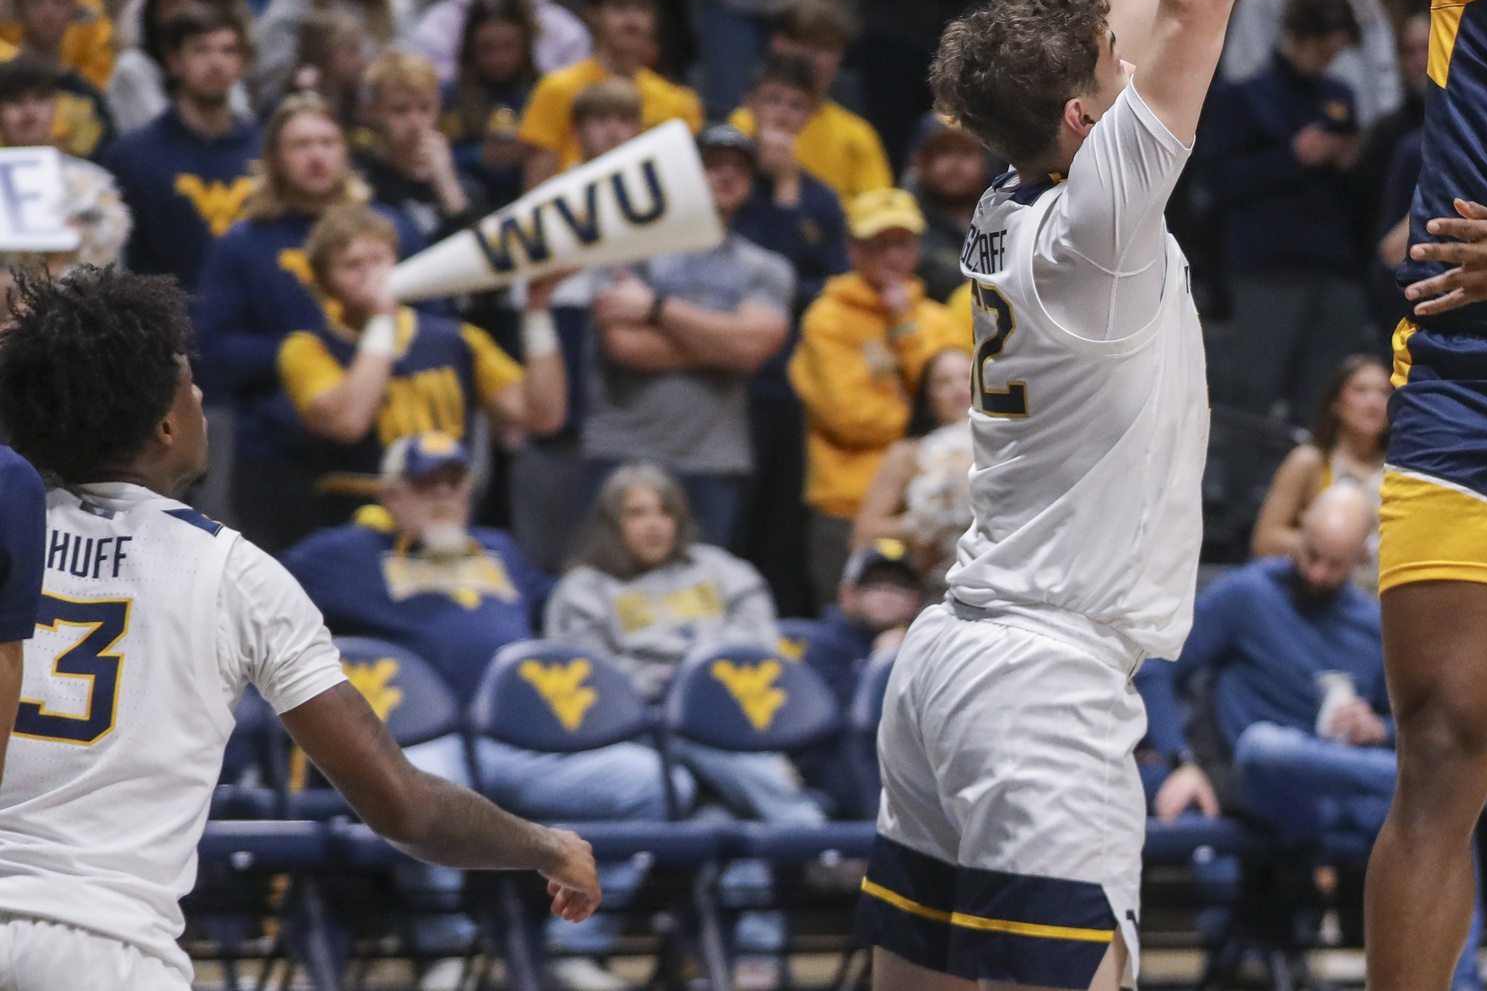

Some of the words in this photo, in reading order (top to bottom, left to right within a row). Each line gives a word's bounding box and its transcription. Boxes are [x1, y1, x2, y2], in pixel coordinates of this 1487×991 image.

[473, 159, 667, 273] WVU
[970, 278, 1029, 419] 2
[47, 529, 132, 579] HUFF
[10, 590, 132, 747] 3
